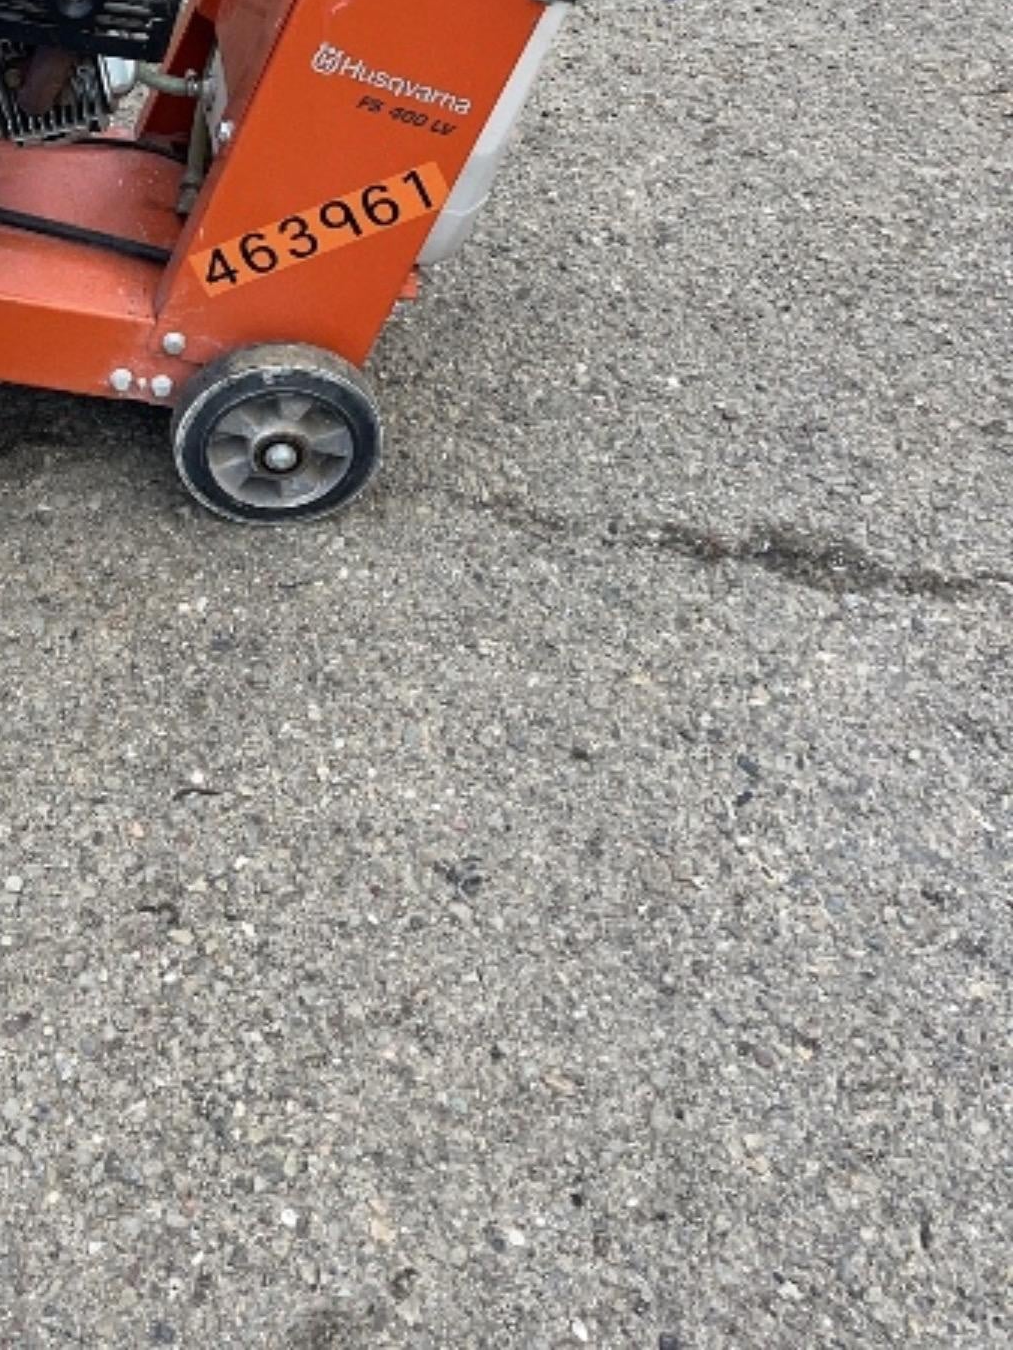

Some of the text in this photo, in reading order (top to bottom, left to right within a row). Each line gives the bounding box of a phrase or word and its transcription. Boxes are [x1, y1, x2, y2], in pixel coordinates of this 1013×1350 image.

[340, 55, 472, 115] Husqvarna
[355, 95, 457, 136] FS 400 LV
[205, 170, 433, 285] 463961
